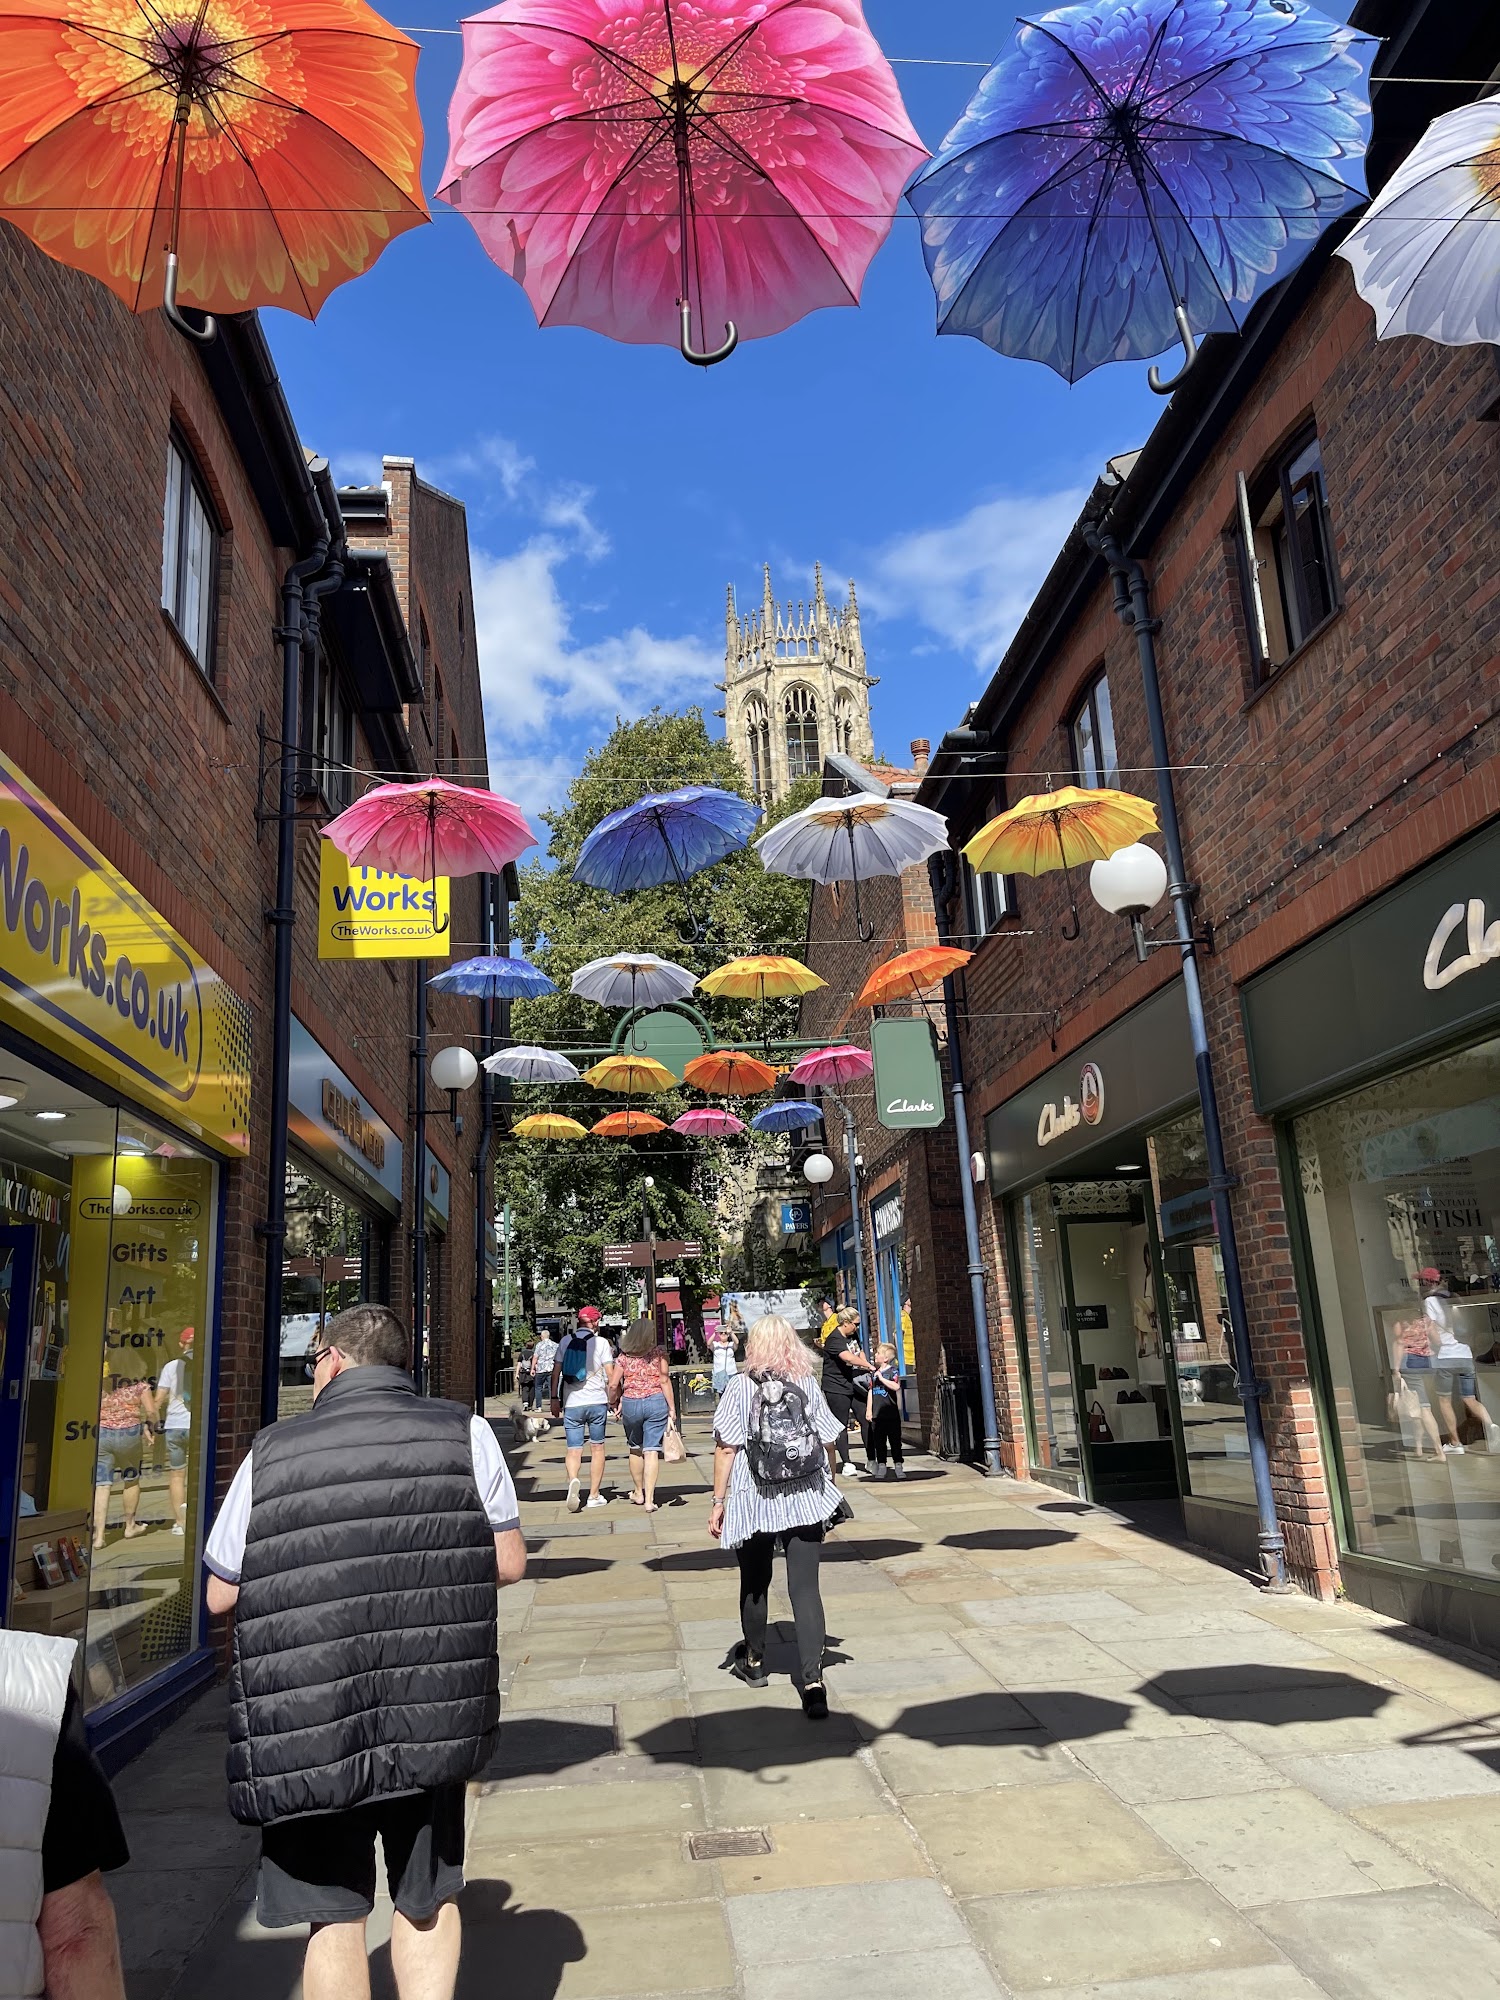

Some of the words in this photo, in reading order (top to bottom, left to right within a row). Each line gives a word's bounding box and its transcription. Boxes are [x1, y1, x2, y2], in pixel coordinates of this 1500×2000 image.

[333, 884, 437, 911] Works
[337, 925, 432, 936] TheWorks.co.uk
[886, 1098, 935, 1114] Clarks
[1037, 1095, 1081, 1147] Clarks
[15, 1183, 28, 1213] TO
[27, 1188, 61, 1225] SCHOOL
[89, 1203, 193, 1215] TheWorks.co.uk
[785, 1222, 809, 1230] PAVERS
[112, 1243, 168, 1263] Gifts
[119, 1286, 156, 1305] Art
[106, 1328, 165, 1348] Craft
